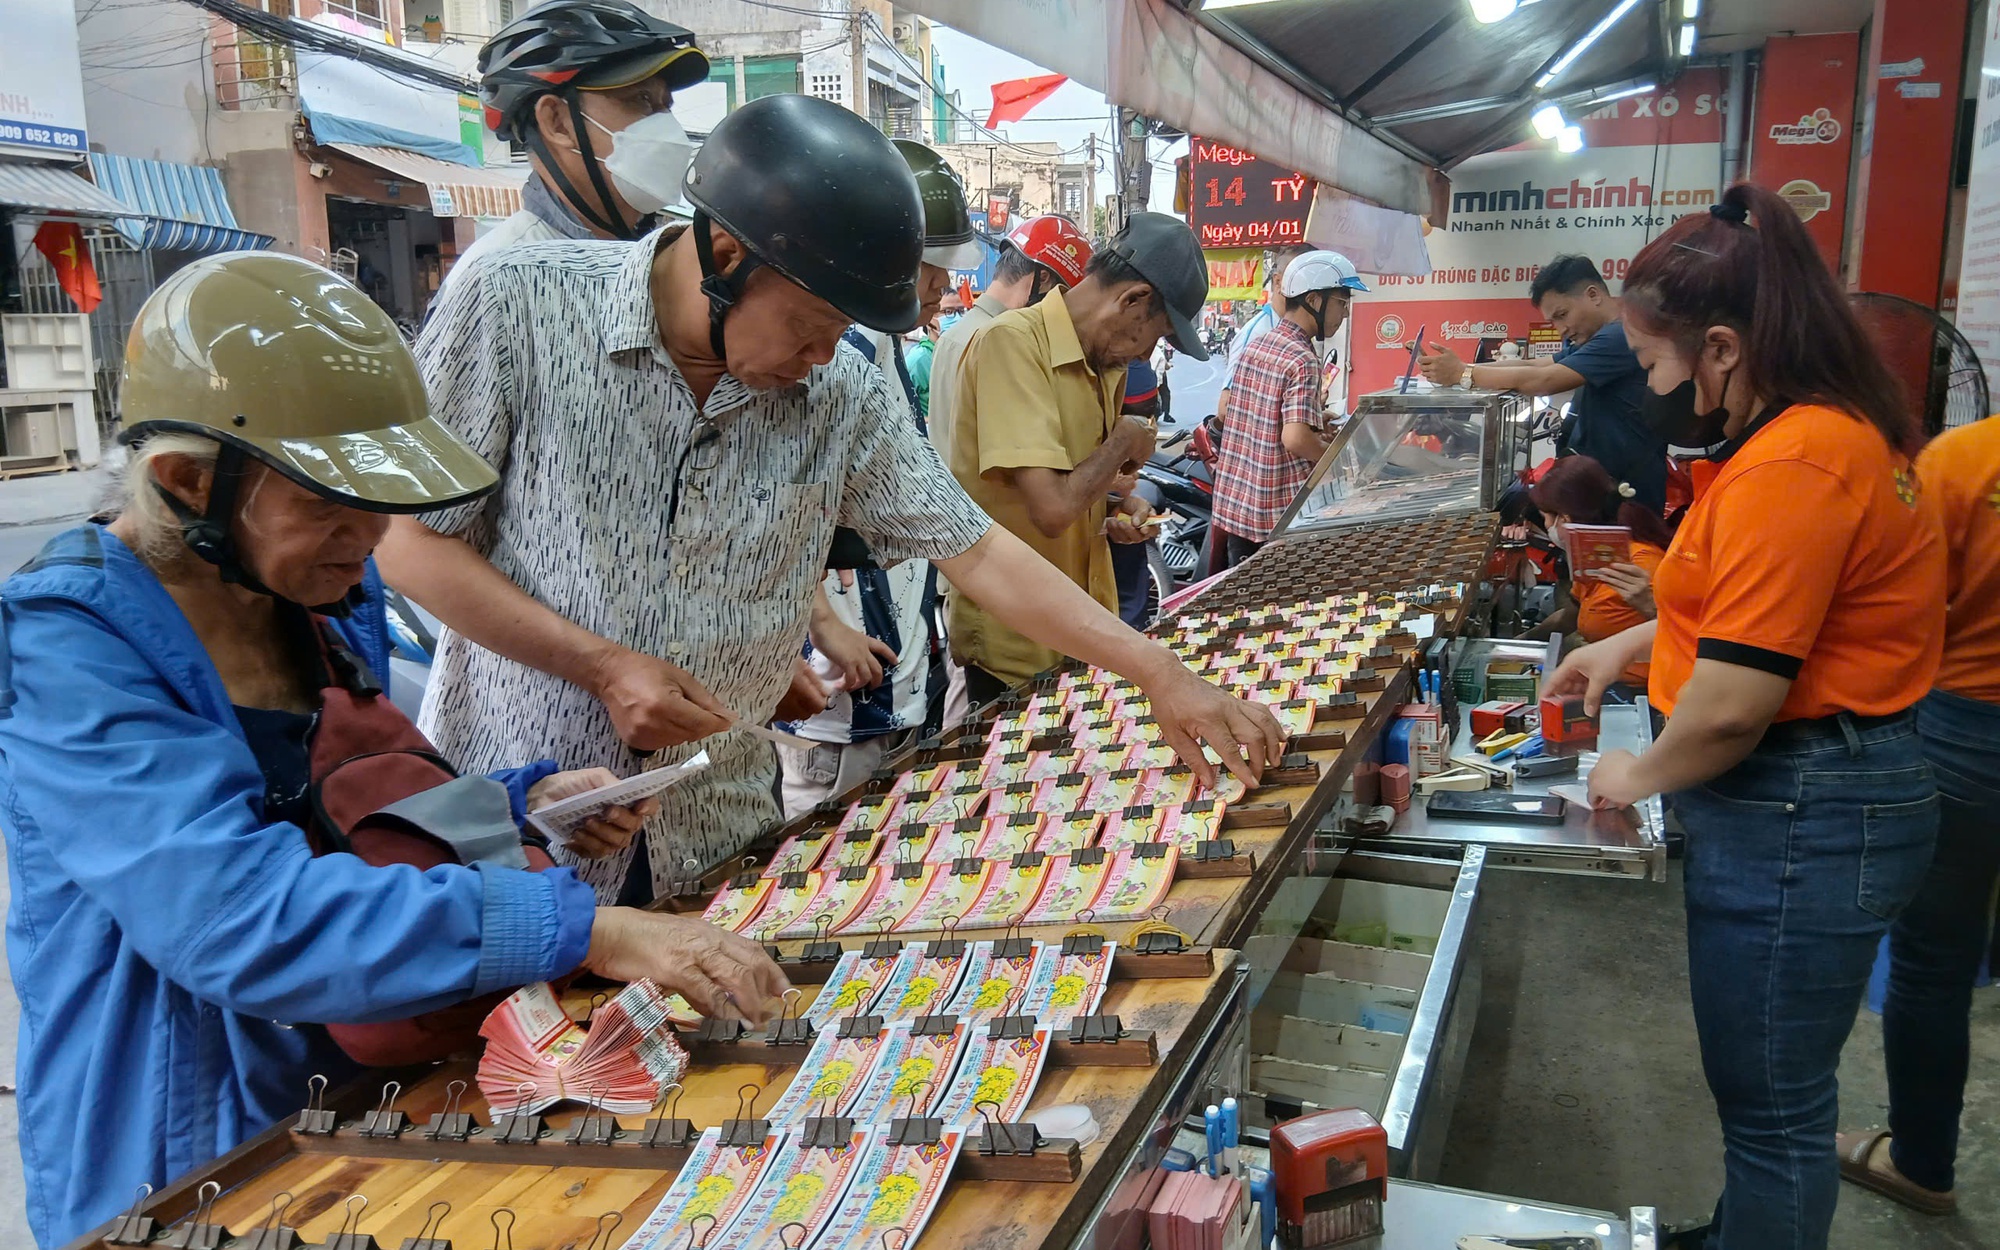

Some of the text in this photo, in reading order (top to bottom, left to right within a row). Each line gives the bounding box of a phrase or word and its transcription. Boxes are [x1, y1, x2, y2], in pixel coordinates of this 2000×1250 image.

[1632, 88, 1680, 118] XỔ
[25, 128, 51, 144] 652
[1772, 126, 1815, 137] Mega
[1205, 177, 1247, 208] 14
[1453, 177, 1715, 213] minhchính.com
[1202, 220, 1301, 243] Ngày 04/01
[1451, 219, 1505, 232] Nhanh
[1510, 215, 1550, 229] Nhất
[1556, 217, 1568, 228] &
[1574, 213, 1625, 228] Chính
[1632, 213, 1664, 227] Xác
[1431, 266, 1477, 284] TRÚNG
[1481, 265, 1510, 286] ĐẶC
